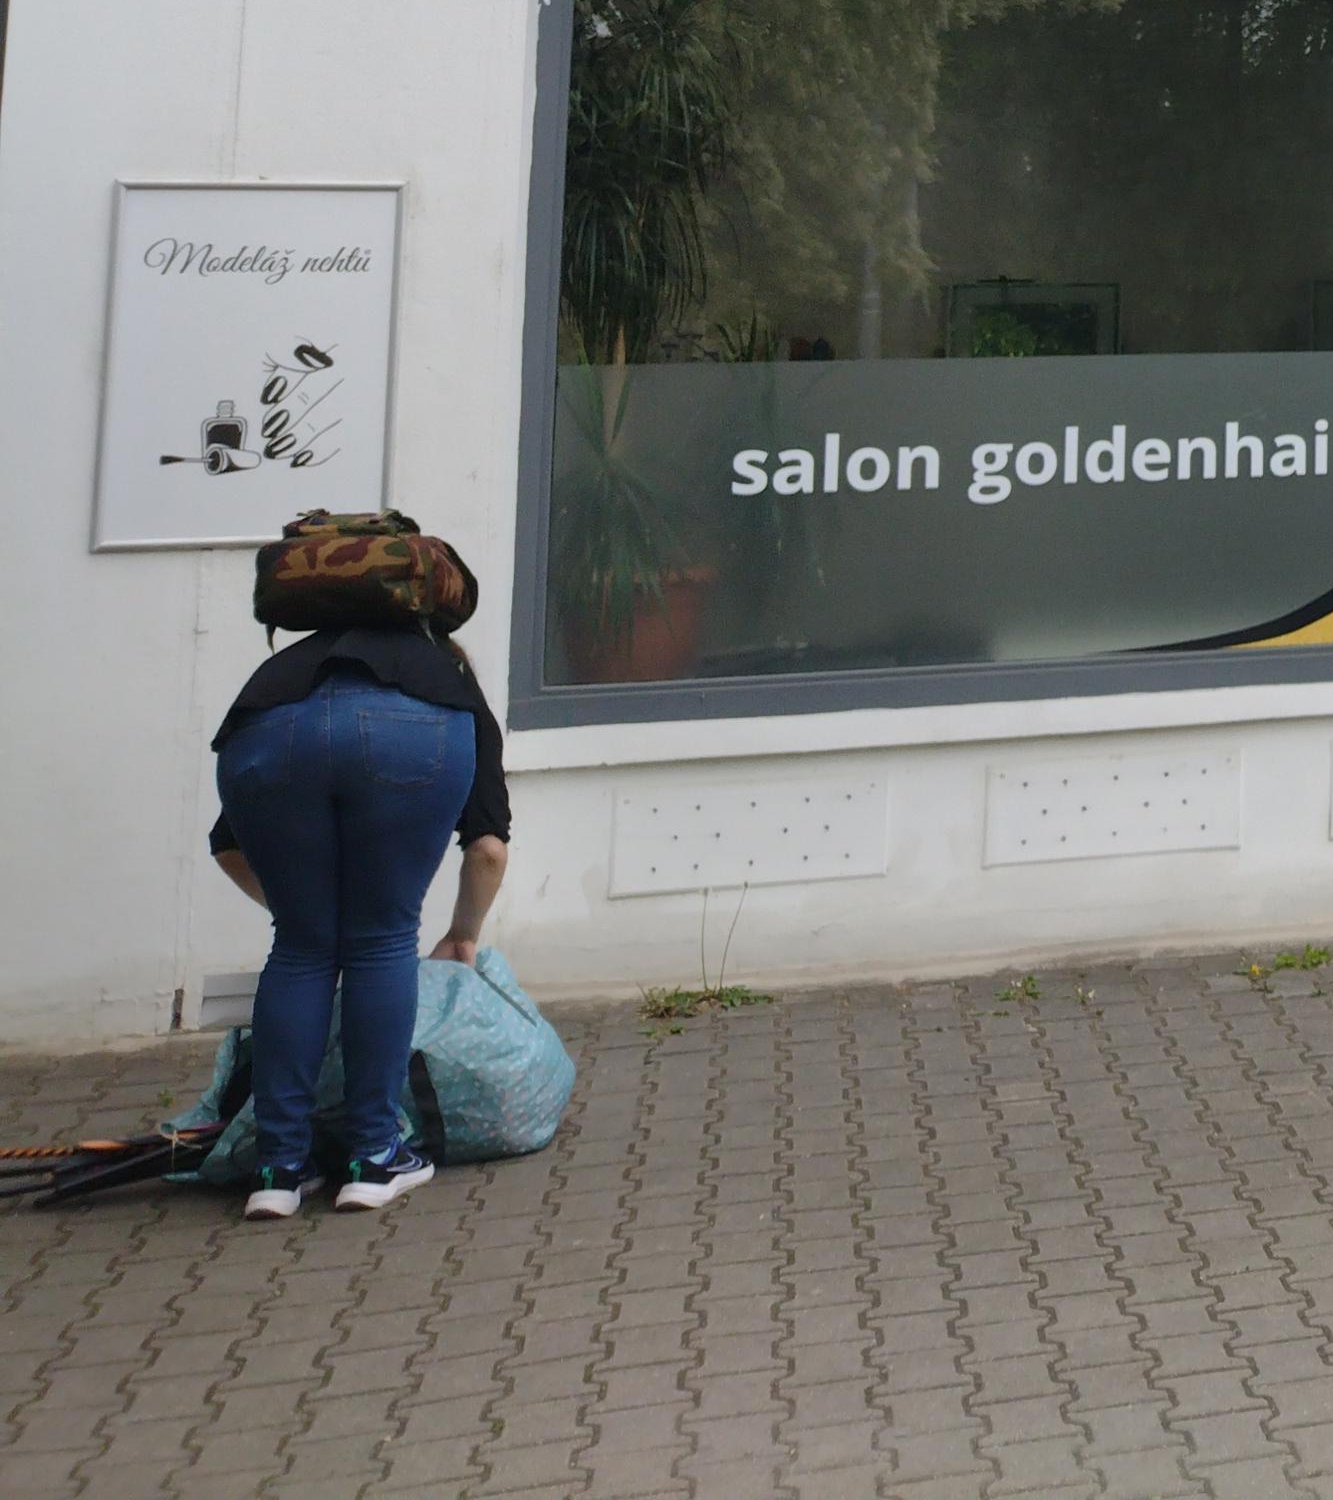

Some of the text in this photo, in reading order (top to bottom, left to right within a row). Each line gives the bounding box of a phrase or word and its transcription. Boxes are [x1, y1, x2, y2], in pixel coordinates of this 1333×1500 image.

[144, 238, 373, 285] Modeláž nehtů
[730, 433, 941, 496] salon
